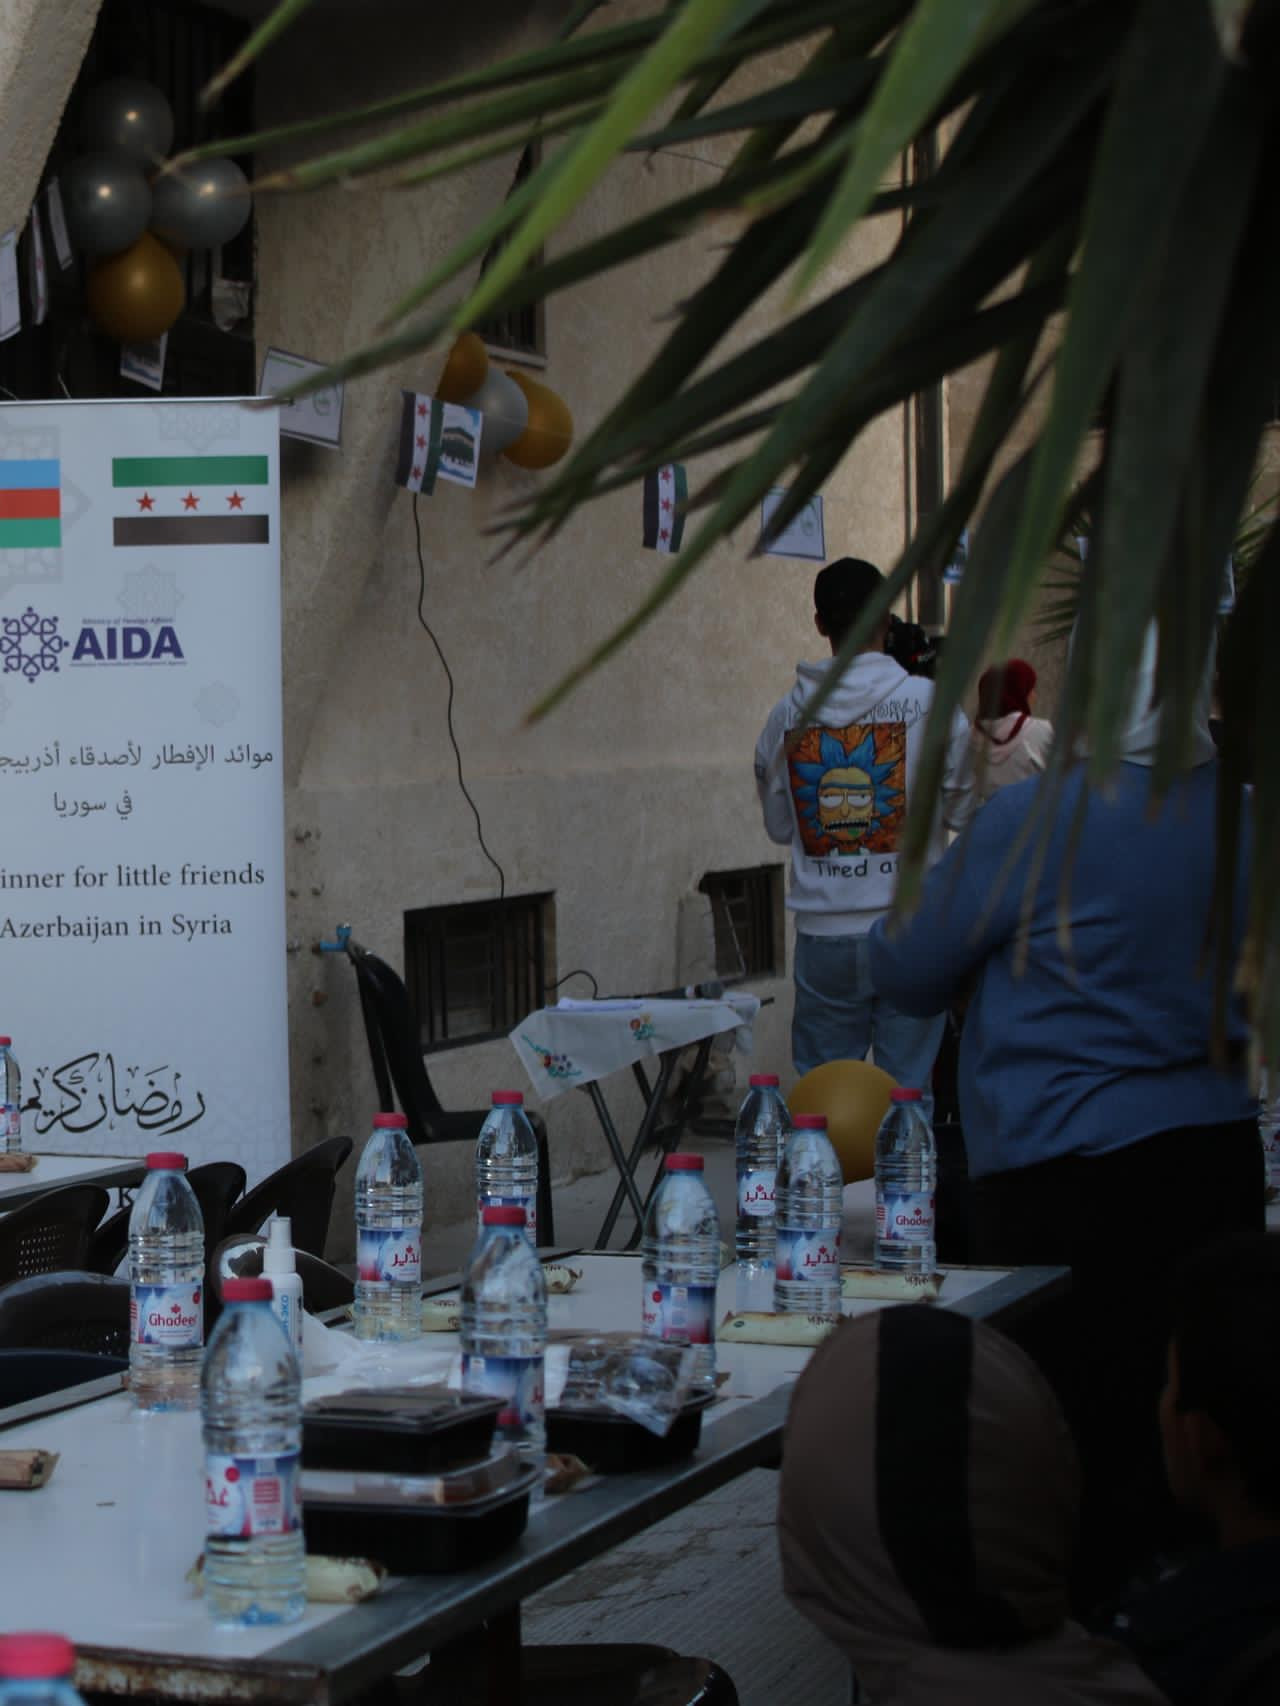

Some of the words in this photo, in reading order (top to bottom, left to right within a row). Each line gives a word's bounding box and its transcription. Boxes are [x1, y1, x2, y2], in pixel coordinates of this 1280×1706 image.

[71, 626, 185, 660] AIDA
[69, 740, 142, 767] لأصدقاء
[151, 743, 215, 771] الإفطار
[223, 743, 274, 769] موائد
[53, 791, 107, 818] سوريا
[115, 789, 133, 821] في
[74, 865, 109, 888] for
[117, 864, 172, 887] little
[180, 861, 265, 886] friends
[812, 858, 868, 878] Tired
[0, 914, 130, 945] Azerbaijan
[138, 915, 163, 937] in
[171, 913, 233, 943] Syria
